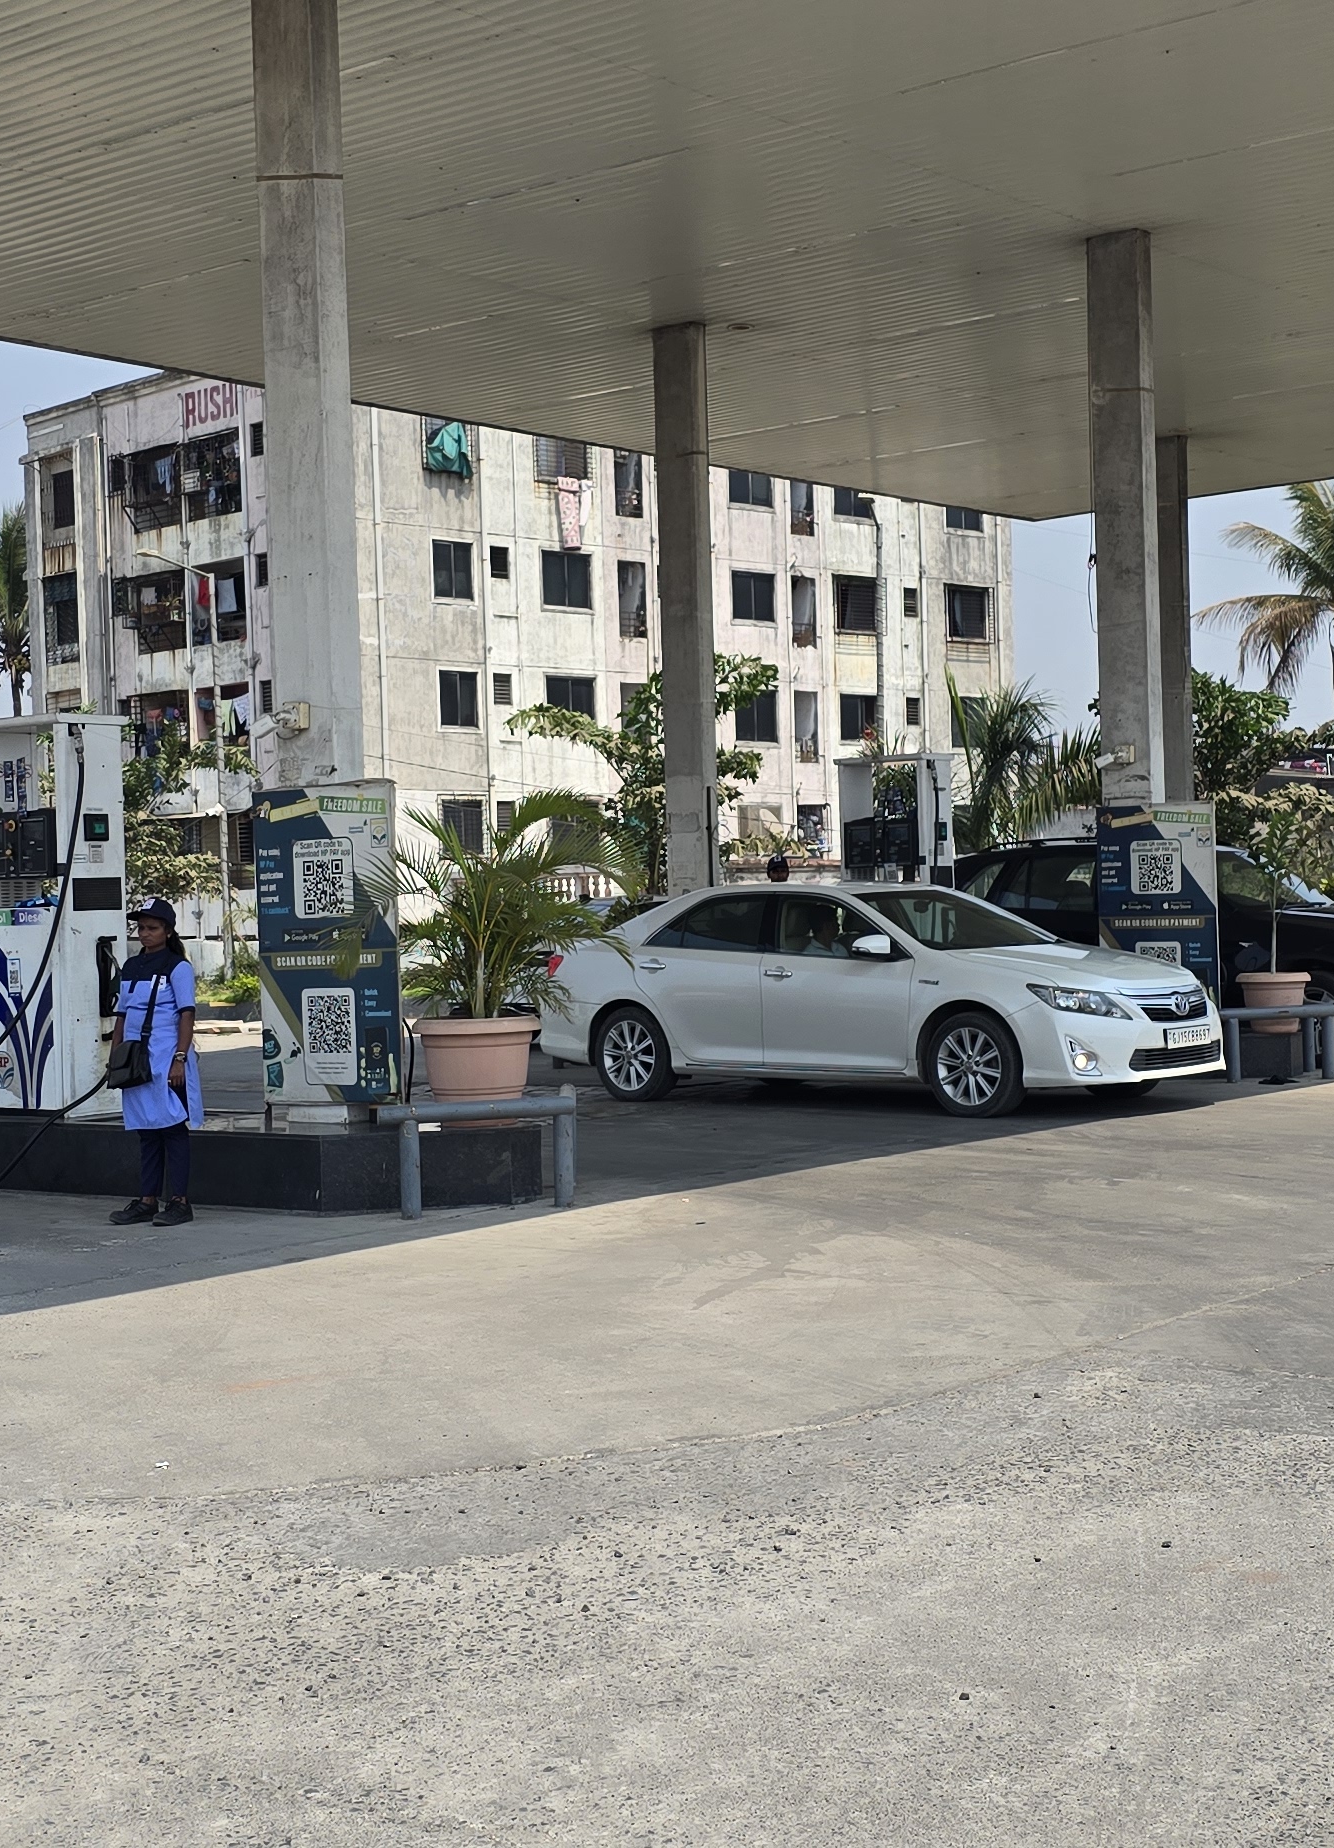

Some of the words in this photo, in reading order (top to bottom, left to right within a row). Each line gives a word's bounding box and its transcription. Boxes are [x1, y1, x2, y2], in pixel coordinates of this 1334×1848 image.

[362, 800, 383, 812] SALE
[1156, 812, 1188, 823] FREEDOM
[1190, 813, 1207, 823] SALE
[1114, 919, 1130, 927] SCAN
[1140, 919, 1157, 927] CODE
[1157, 918, 1169, 926] FOR
[1170, 918, 1200, 926] PAYMENT
[291, 934, 308, 942] Google
[276, 956, 296, 967] SCAN
[296, 956, 307, 966] QR
[307, 955, 326, 966] CODE
